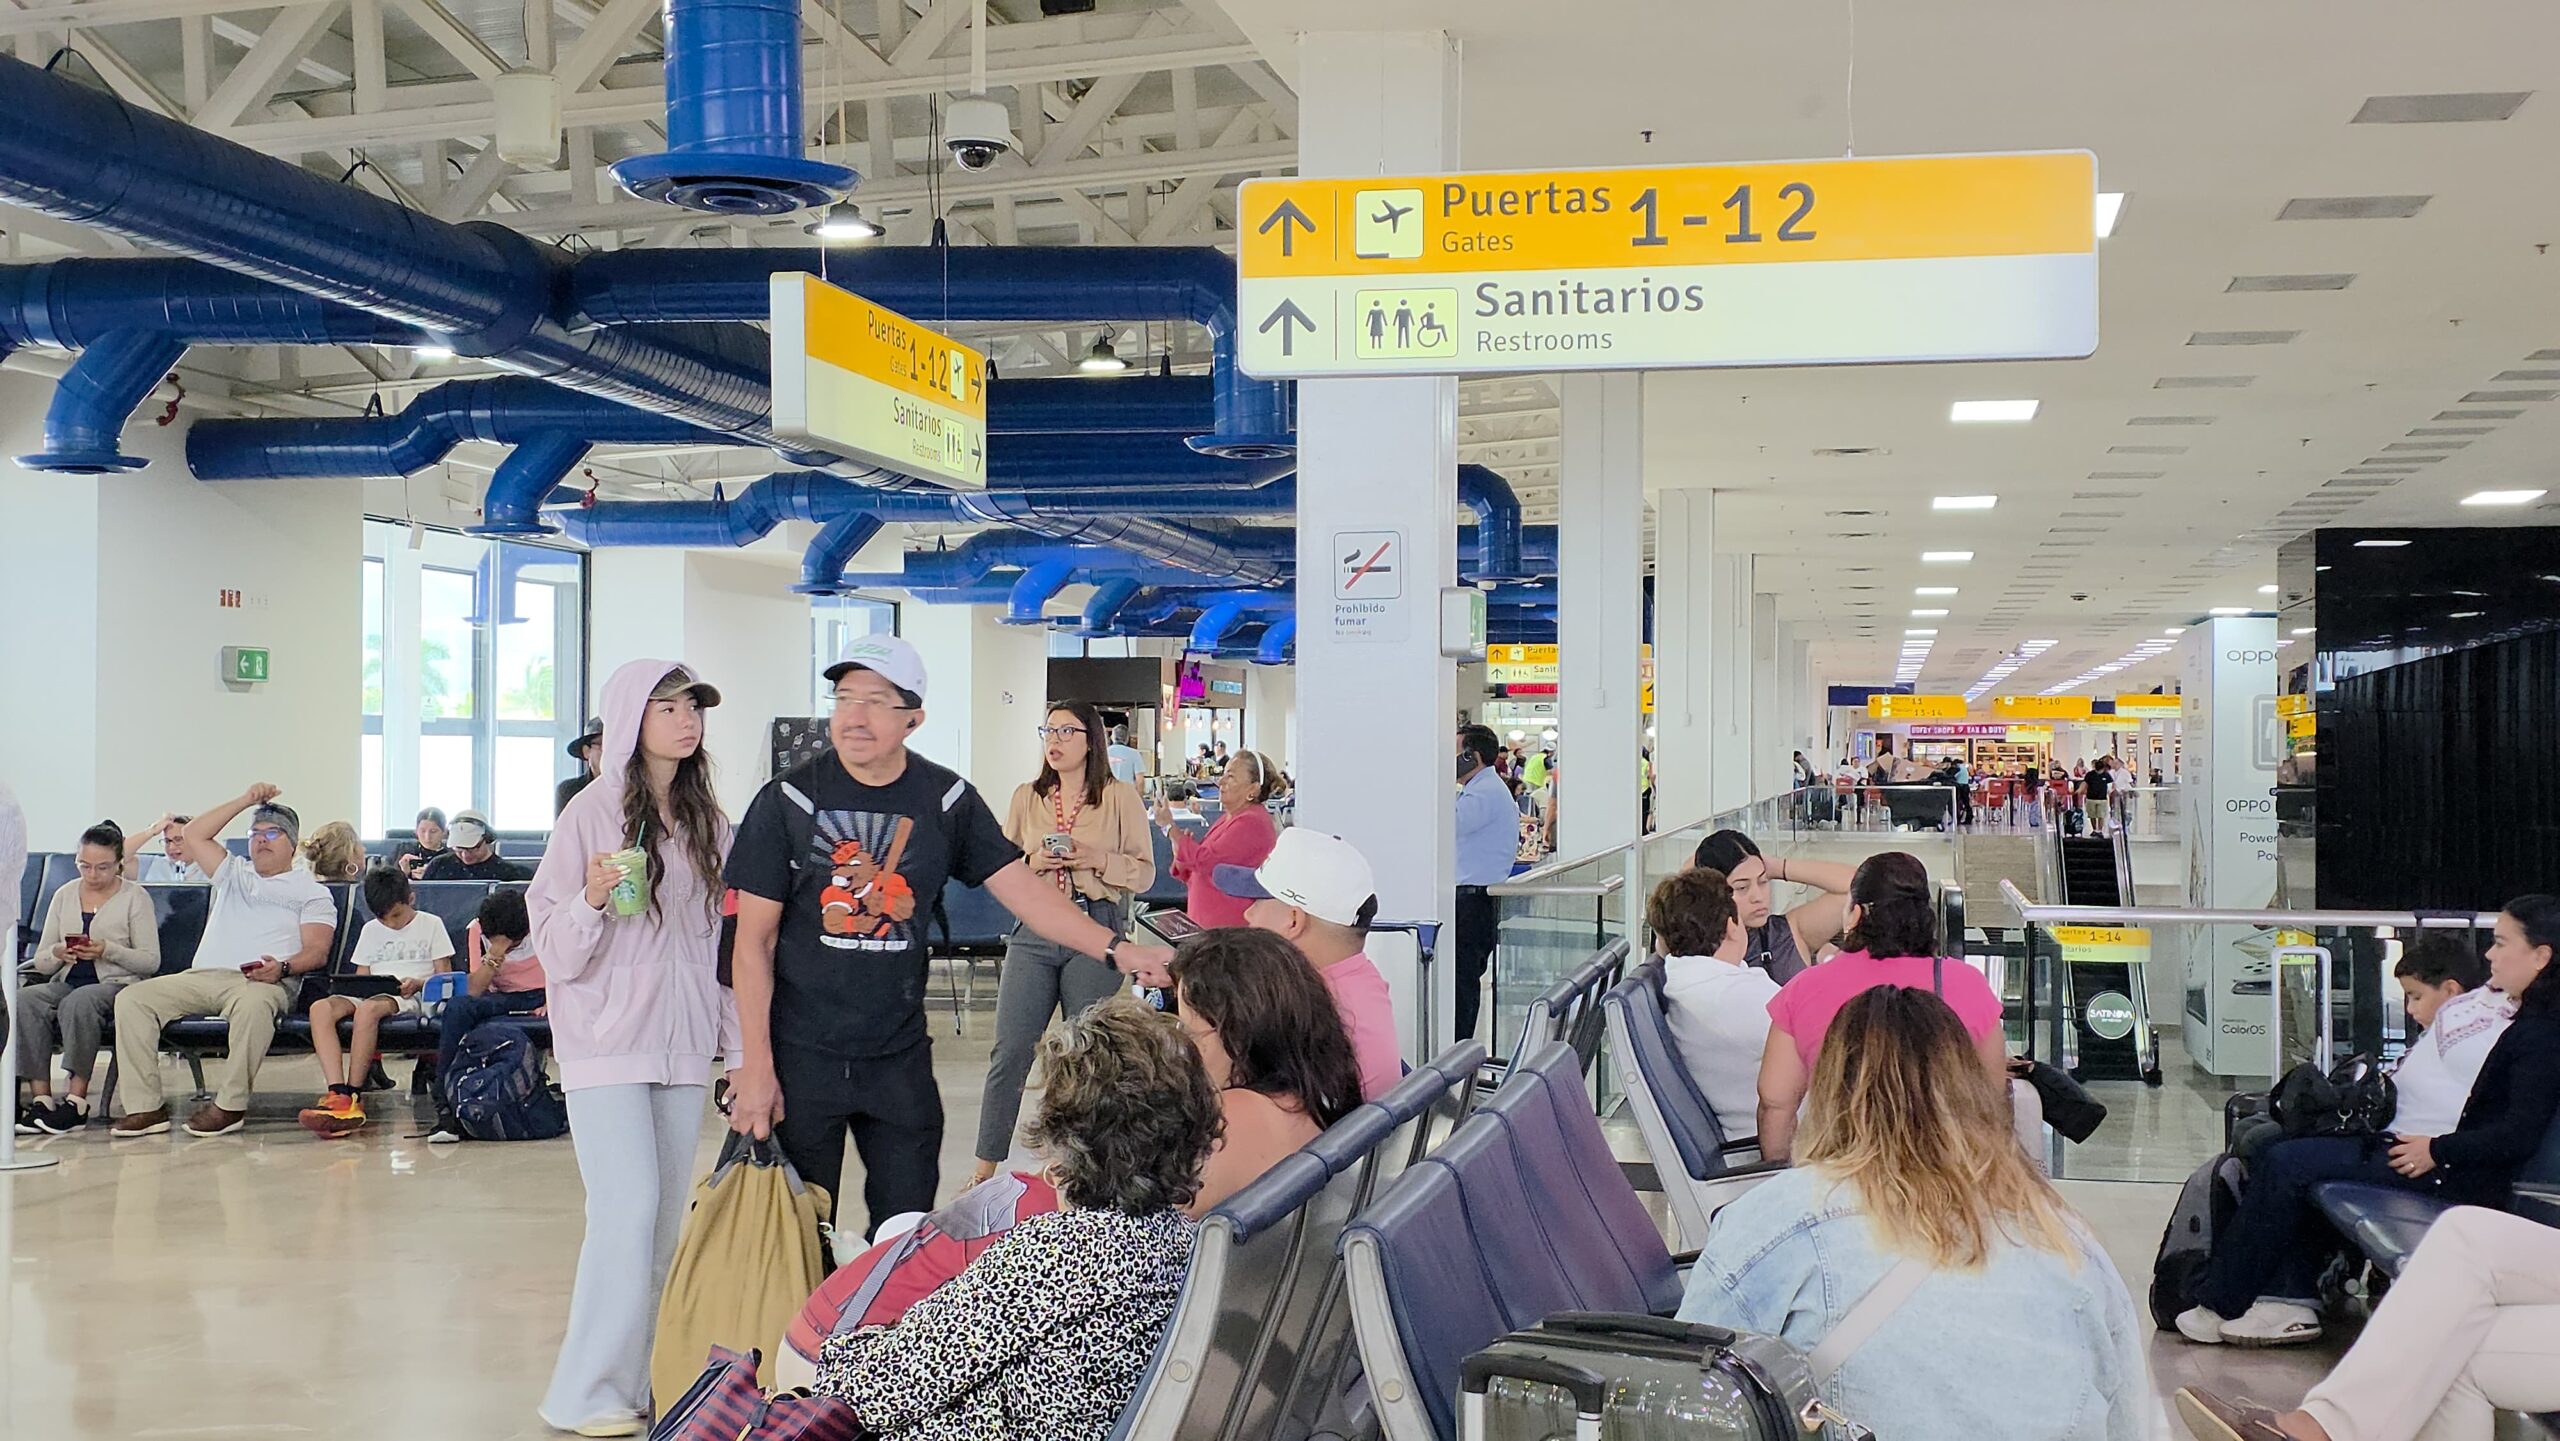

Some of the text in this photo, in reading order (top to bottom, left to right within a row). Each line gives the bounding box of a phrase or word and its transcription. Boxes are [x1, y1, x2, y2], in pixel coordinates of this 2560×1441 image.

[1442, 182, 1818, 248] Puertas 1-12
[1441, 229, 1514, 254] Gates
[1475, 278, 1704, 318] Sanitarios
[1476, 327, 1613, 353] Restrooms
[868, 310, 947, 392] Puertas 1-12
[894, 397, 942, 437] Sanitarios
[912, 438, 942, 463] Restrooms
[1335, 603, 1386, 614] Prohibido
[1335, 616, 1366, 626] fumar
[2226, 650, 2278, 665] opp
[1534, 665, 1559, 673] Sanit
[2037, 698, 2061, 706] 1-10
[2226, 799, 2271, 813] OPPO
[2090, 931, 2122, 942] 1-14
[2222, 1024, 2266, 1035] ColorOS
